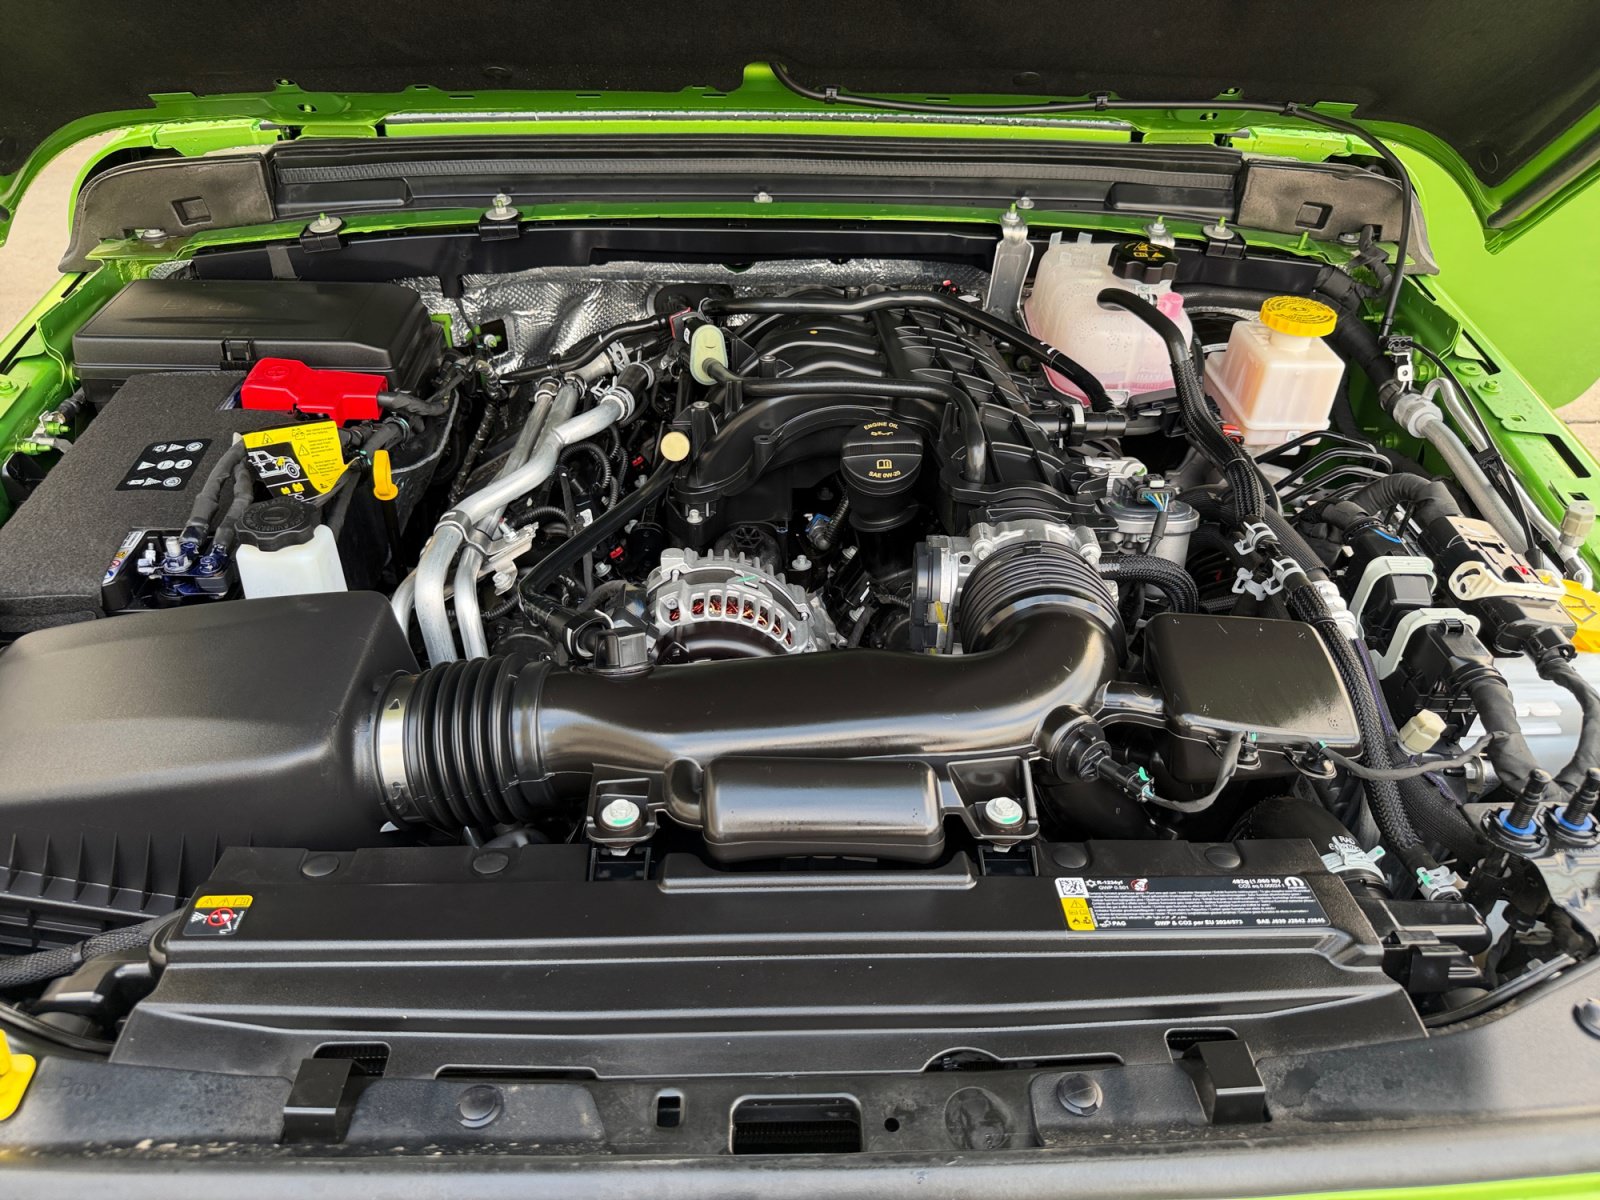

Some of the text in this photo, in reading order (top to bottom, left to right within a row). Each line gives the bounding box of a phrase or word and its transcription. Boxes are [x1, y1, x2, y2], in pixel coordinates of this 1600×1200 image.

[864, 421, 899, 431] ENGINE OIL
[882, 470, 901, 478] 0W-20
